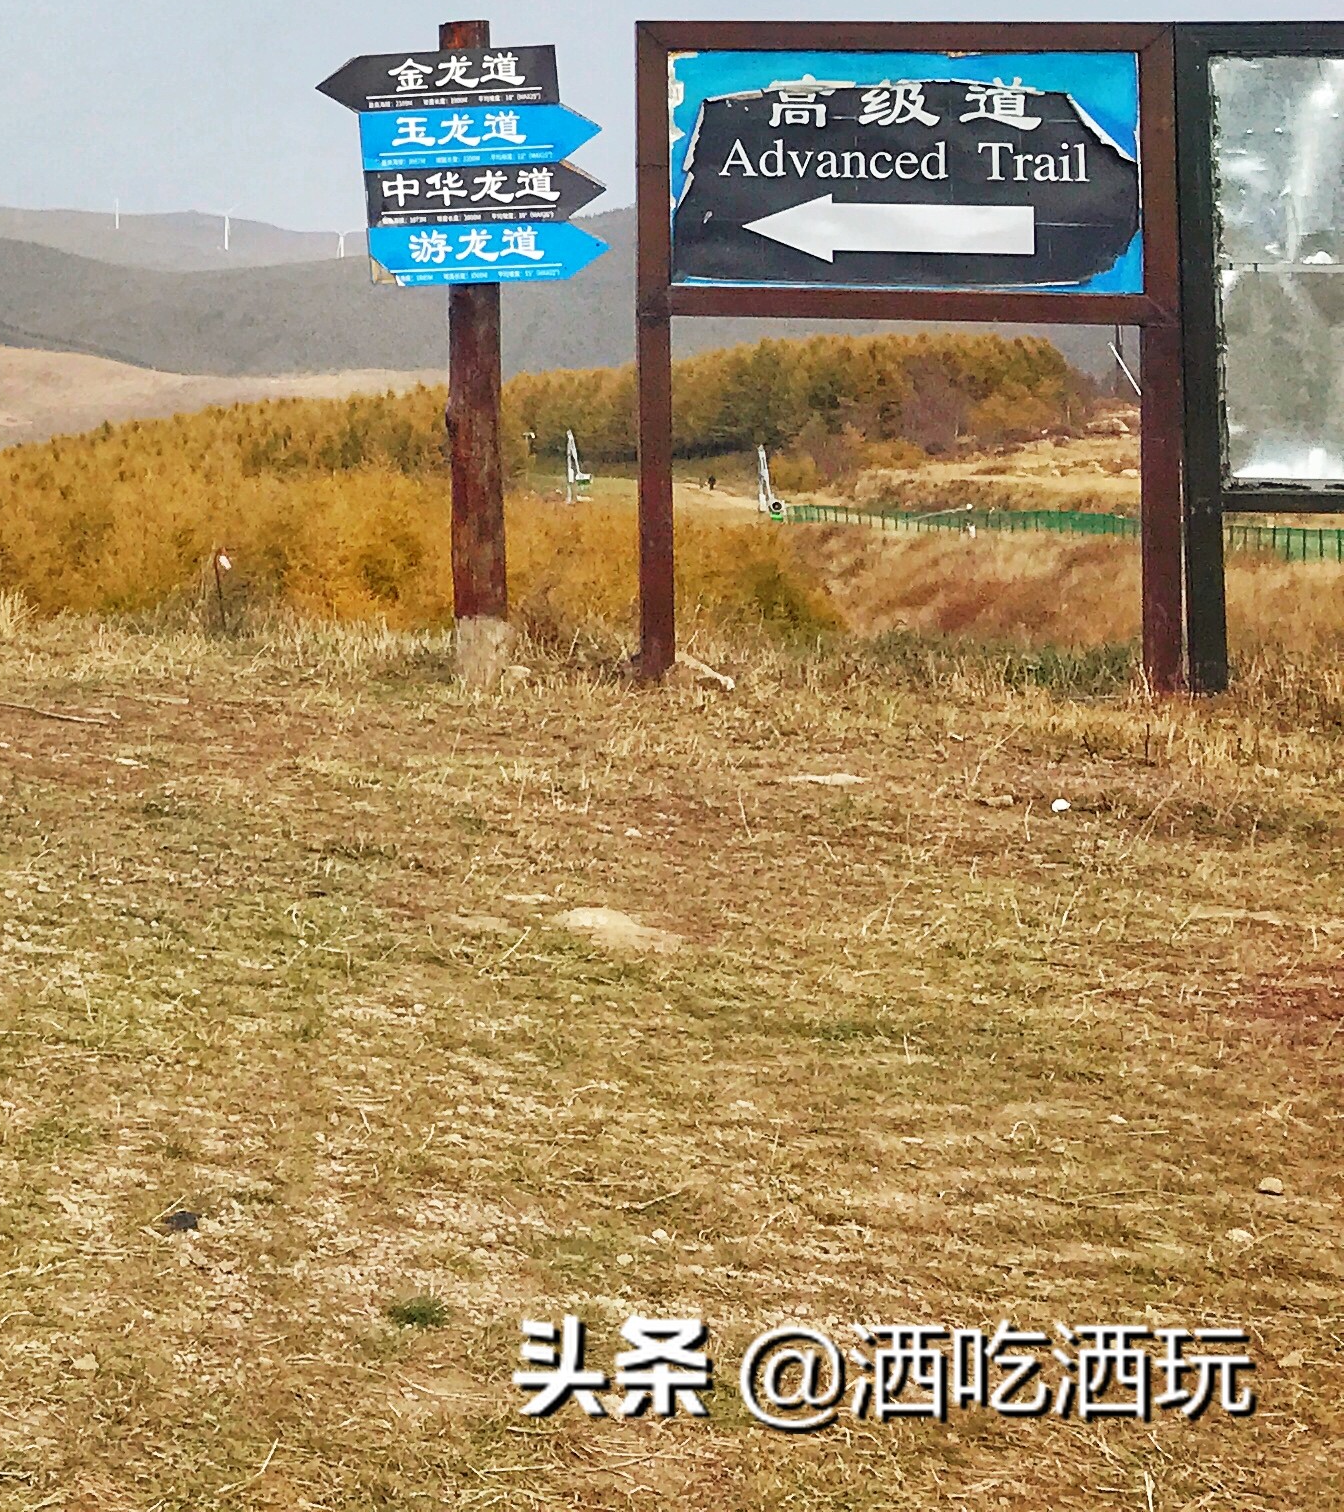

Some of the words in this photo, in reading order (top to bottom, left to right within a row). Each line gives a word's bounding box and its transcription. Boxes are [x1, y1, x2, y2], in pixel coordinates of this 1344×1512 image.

[388, 51, 526, 92] 金龙道
[768, 74, 1042, 130] 高级道
[392, 110, 527, 147] 玉龙道
[718, 139, 949, 182] Advanced
[977, 140, 1090, 183] Trail
[381, 167, 561, 207] 中华龙道
[408, 225, 545, 263] 游龙道
